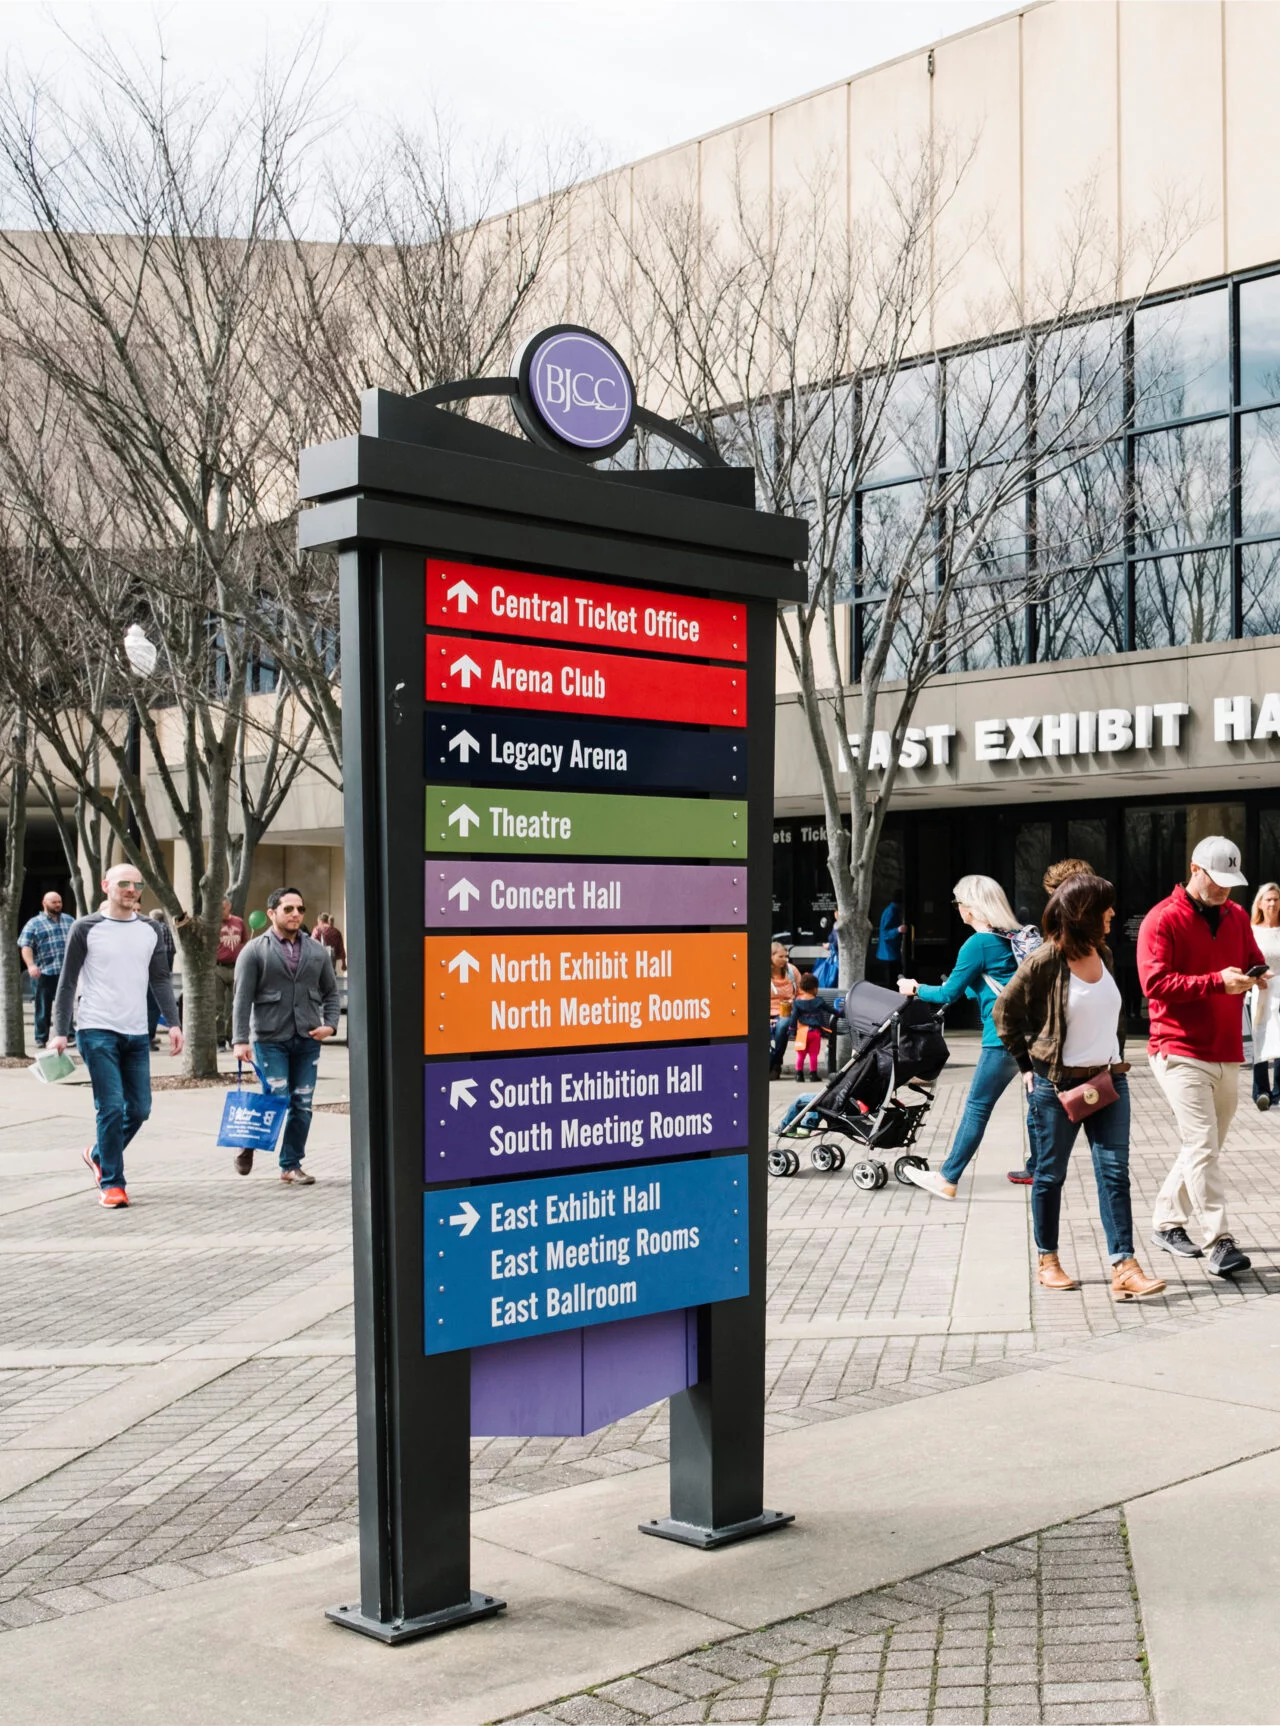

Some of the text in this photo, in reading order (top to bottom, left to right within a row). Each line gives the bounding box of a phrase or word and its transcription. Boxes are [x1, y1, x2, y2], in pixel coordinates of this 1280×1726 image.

[546, 363, 621, 413] BJCC
[491, 585, 700, 642] Central Ticket Office
[491, 661, 606, 699] Arena Club
[491, 733, 628, 773] Legacy Arena
[974, 701, 1190, 761] EXHIBIT
[489, 806, 571, 840] Theatre
[800, 826, 827, 843] Tick
[490, 879, 621, 910] Concert Hall
[491, 950, 672, 983] North Exhibit Hall
[491, 994, 710, 1030] North Meeting Rooms
[489, 1064, 702, 1109] South Exhibition Hall
[489, 1111, 713, 1156] South Meeting Rooms
[491, 1182, 660, 1233] East Exhibit Hall
[491, 1226, 700, 1280] East Meeting Rooms
[491, 1281, 637, 1328] East Ballroom
